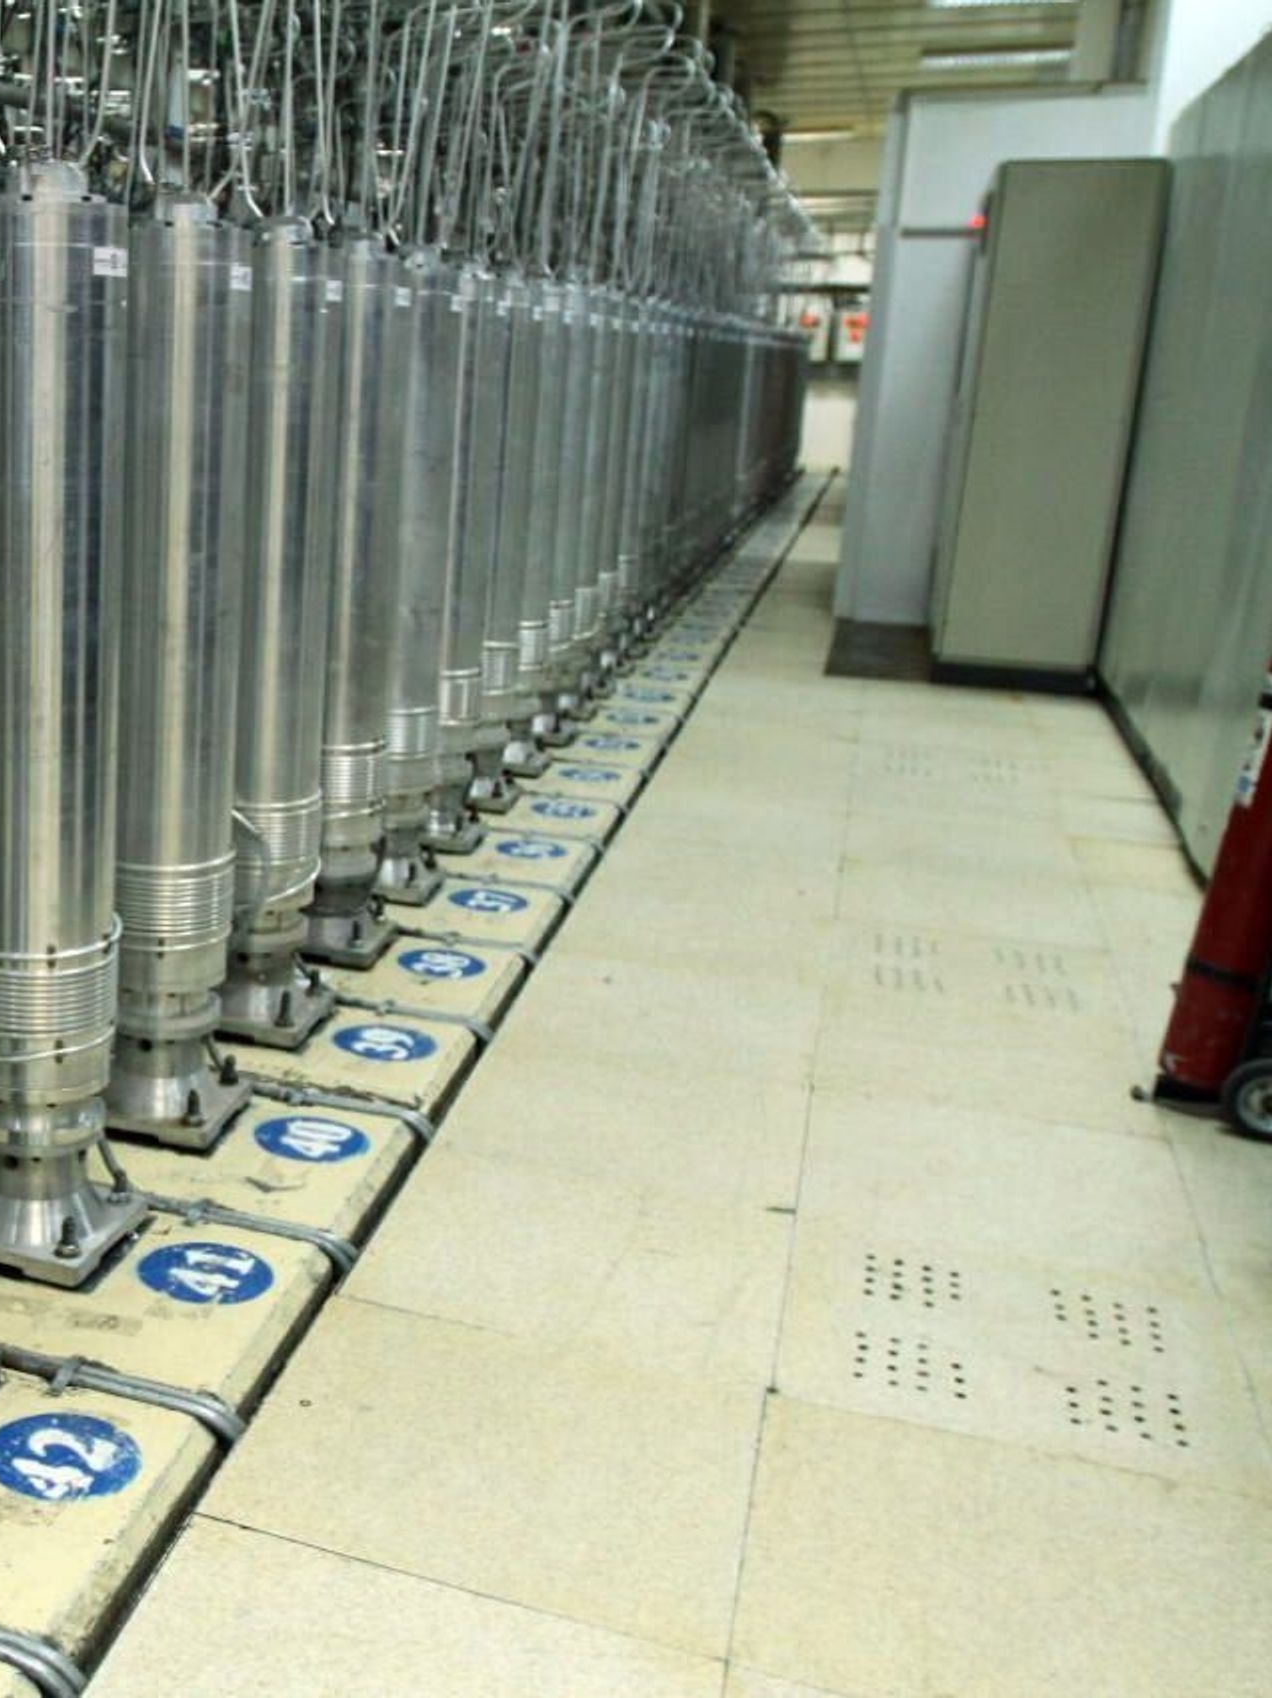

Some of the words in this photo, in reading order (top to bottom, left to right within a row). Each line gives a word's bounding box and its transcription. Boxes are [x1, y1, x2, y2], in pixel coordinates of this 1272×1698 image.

[411, 952, 470, 978] 38
[352, 1028, 414, 1059] 39
[280, 1121, 352, 1158] 40
[169, 1250, 255, 1296] 41
[12, 1429, 119, 1498] 42
